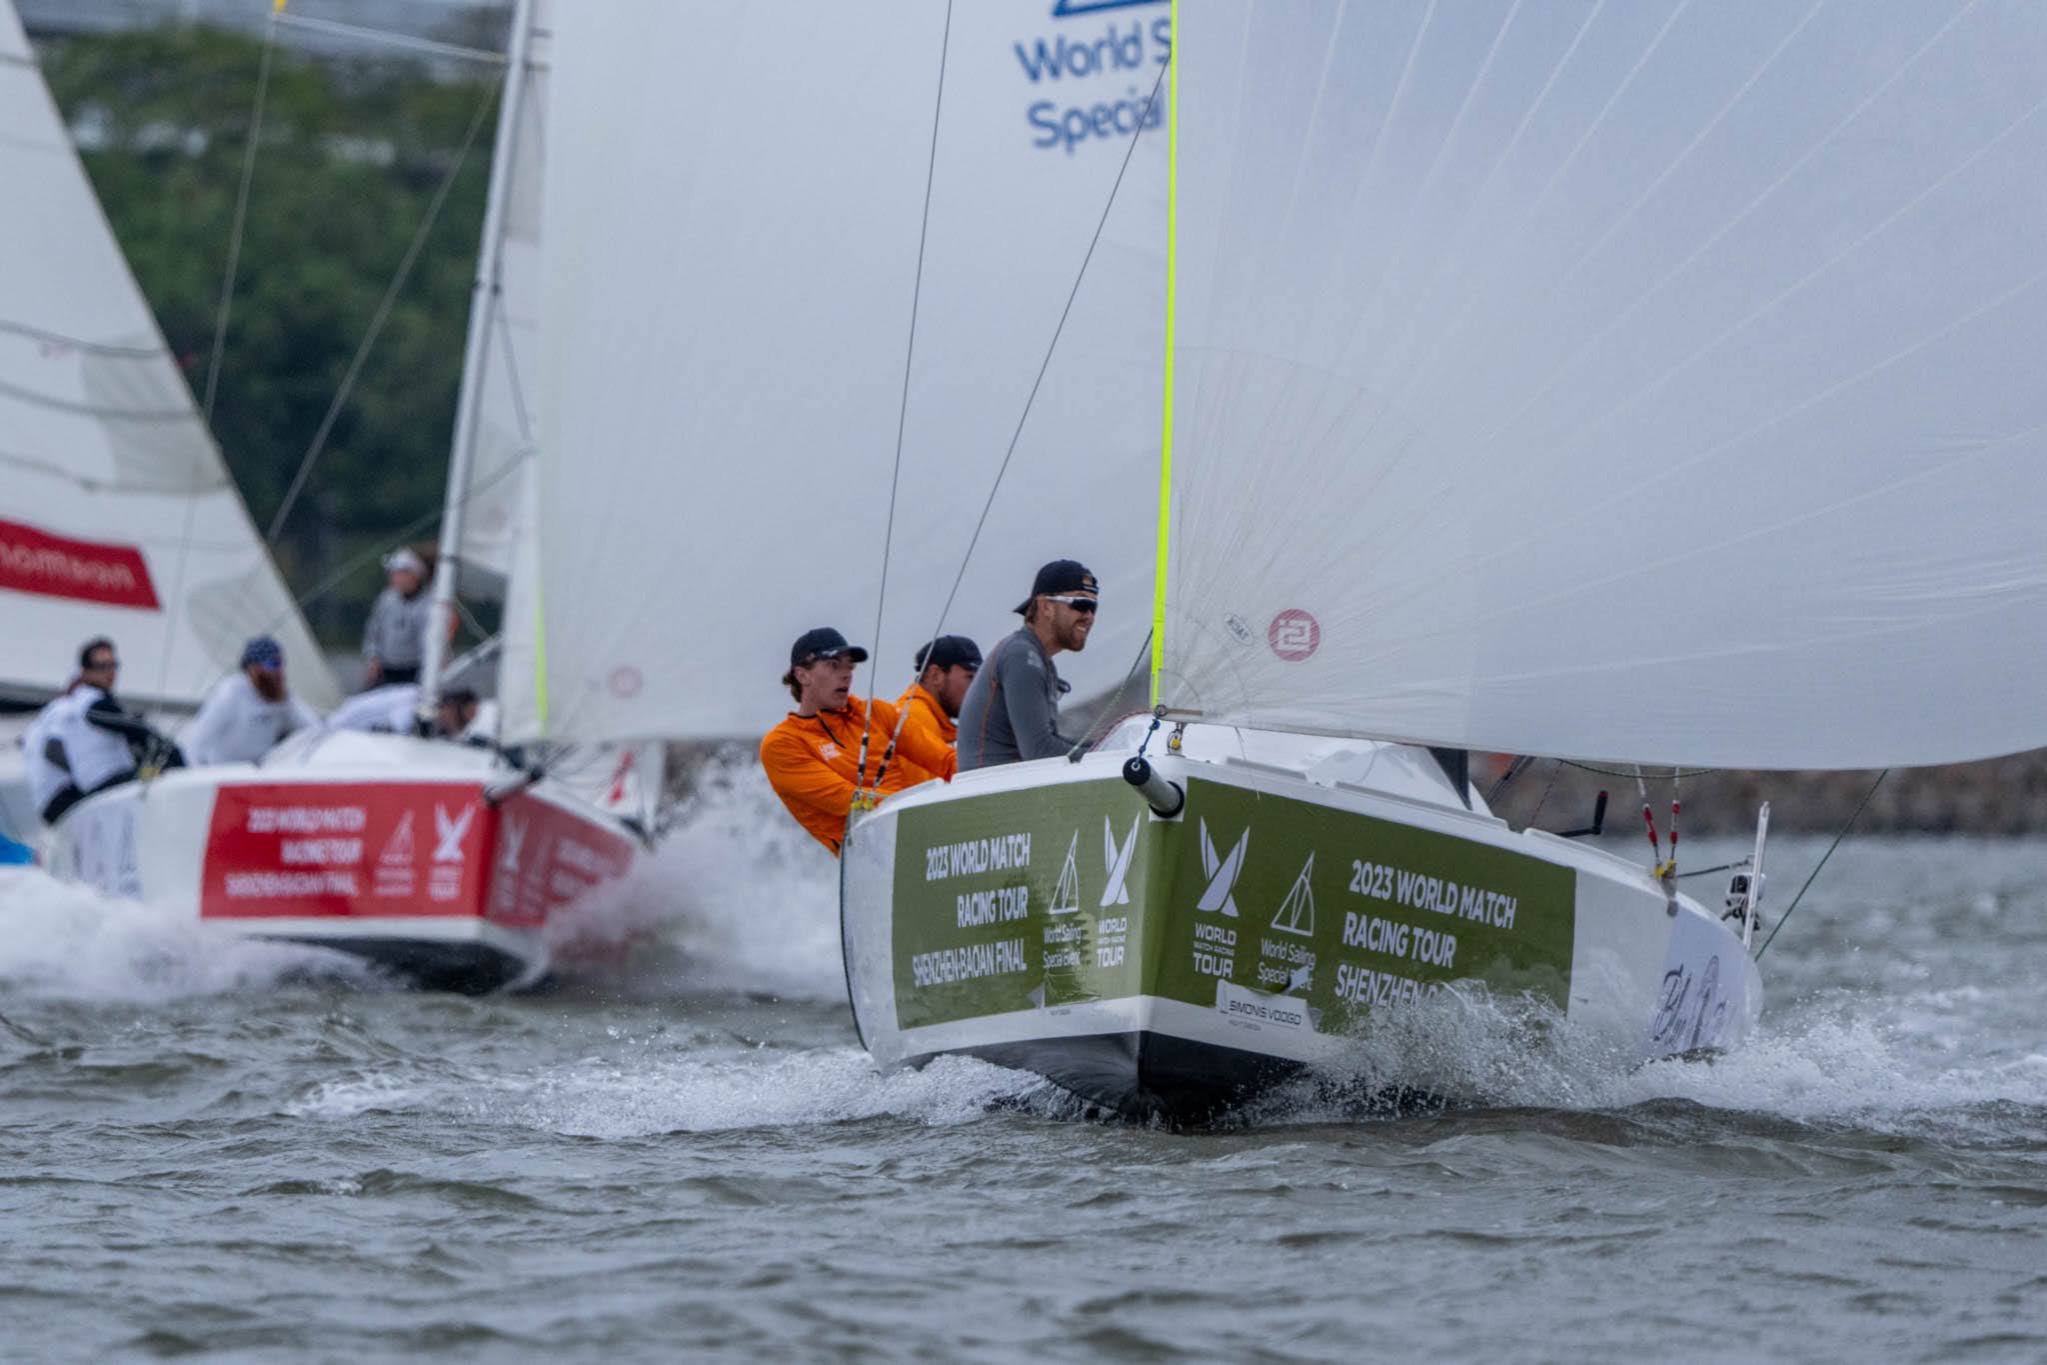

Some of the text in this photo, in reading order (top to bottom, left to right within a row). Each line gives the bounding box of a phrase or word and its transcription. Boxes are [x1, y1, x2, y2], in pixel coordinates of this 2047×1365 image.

[1012, 19, 1143, 83] World
[926, 832, 1031, 881] 2023 WORLD MATCH
[956, 885, 1028, 928] RACING TOUR
[1348, 858, 1518, 930] 2023 WORLD MATCH
[1195, 921, 1238, 946] WORLD
[1261, 938, 1287, 960] World
[1342, 911, 1457, 969] RACING TOUR
[994, 938, 1028, 974] FINAL
[1096, 945, 1125, 968] TOUR
[1193, 952, 1234, 979] TOUR
[1257, 961, 1289, 986] Special
